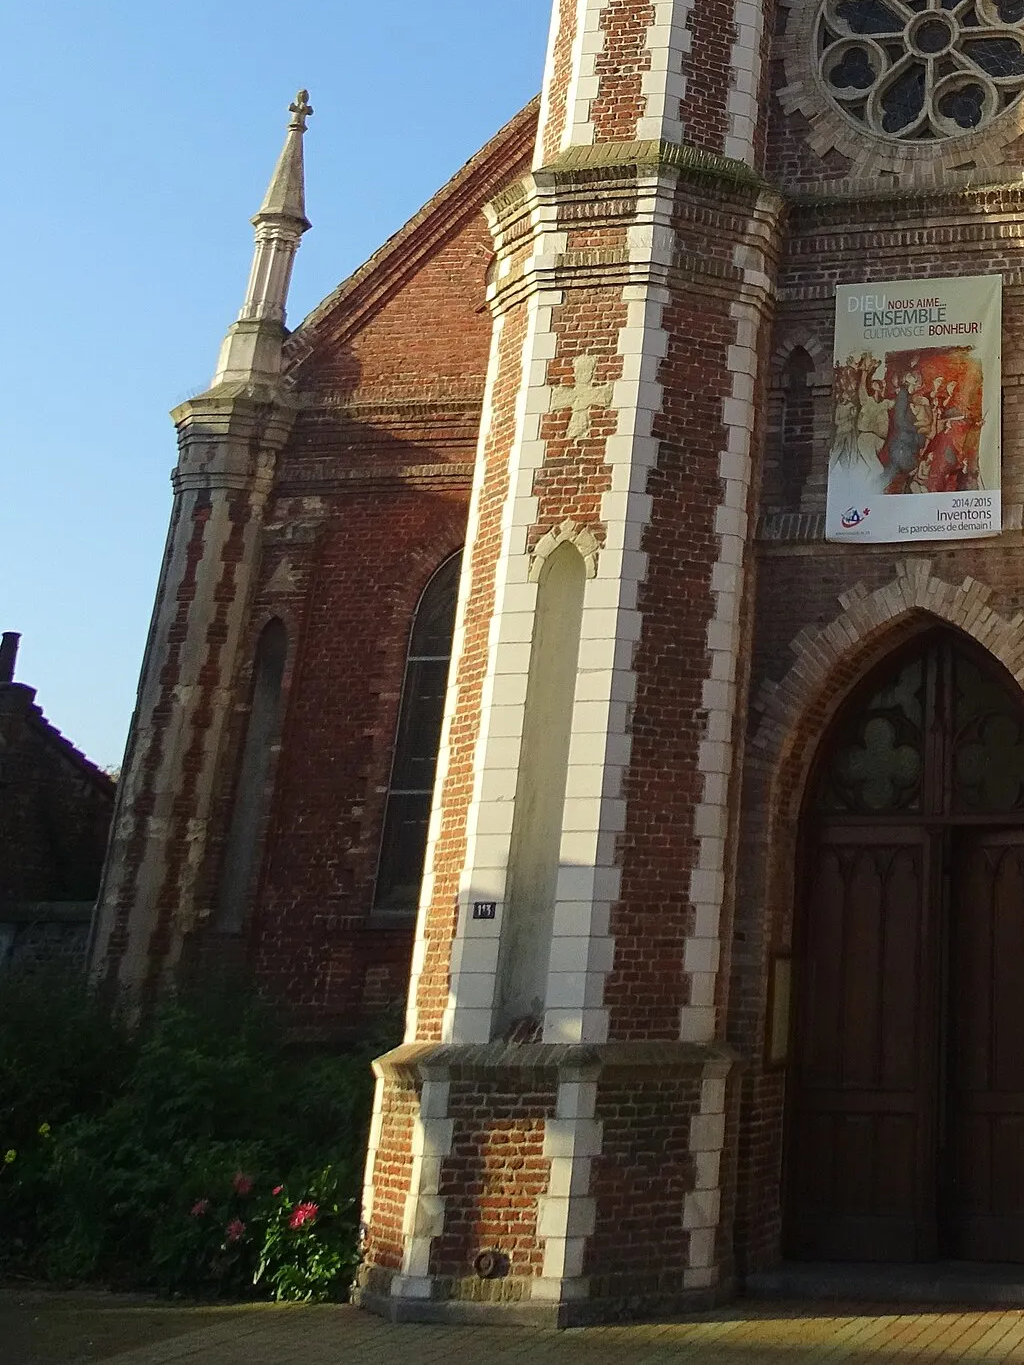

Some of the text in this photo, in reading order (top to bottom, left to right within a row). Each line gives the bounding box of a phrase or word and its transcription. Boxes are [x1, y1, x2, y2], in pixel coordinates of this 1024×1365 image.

[847, 294, 887, 313] DIEU
[887, 298, 914, 310] NOUS
[863, 307, 946, 327] ENSEMBLE
[863, 326, 914, 340] CULTIVONS
[914, 325, 925, 337] CE
[951, 497, 992, 508] 2014/2015
[937, 509, 992, 521] Inventons
[898, 525, 909, 534] les
[909, 523, 945, 534] paroisses
[946, 522, 957, 531] de
[958, 521, 988, 531] demain
